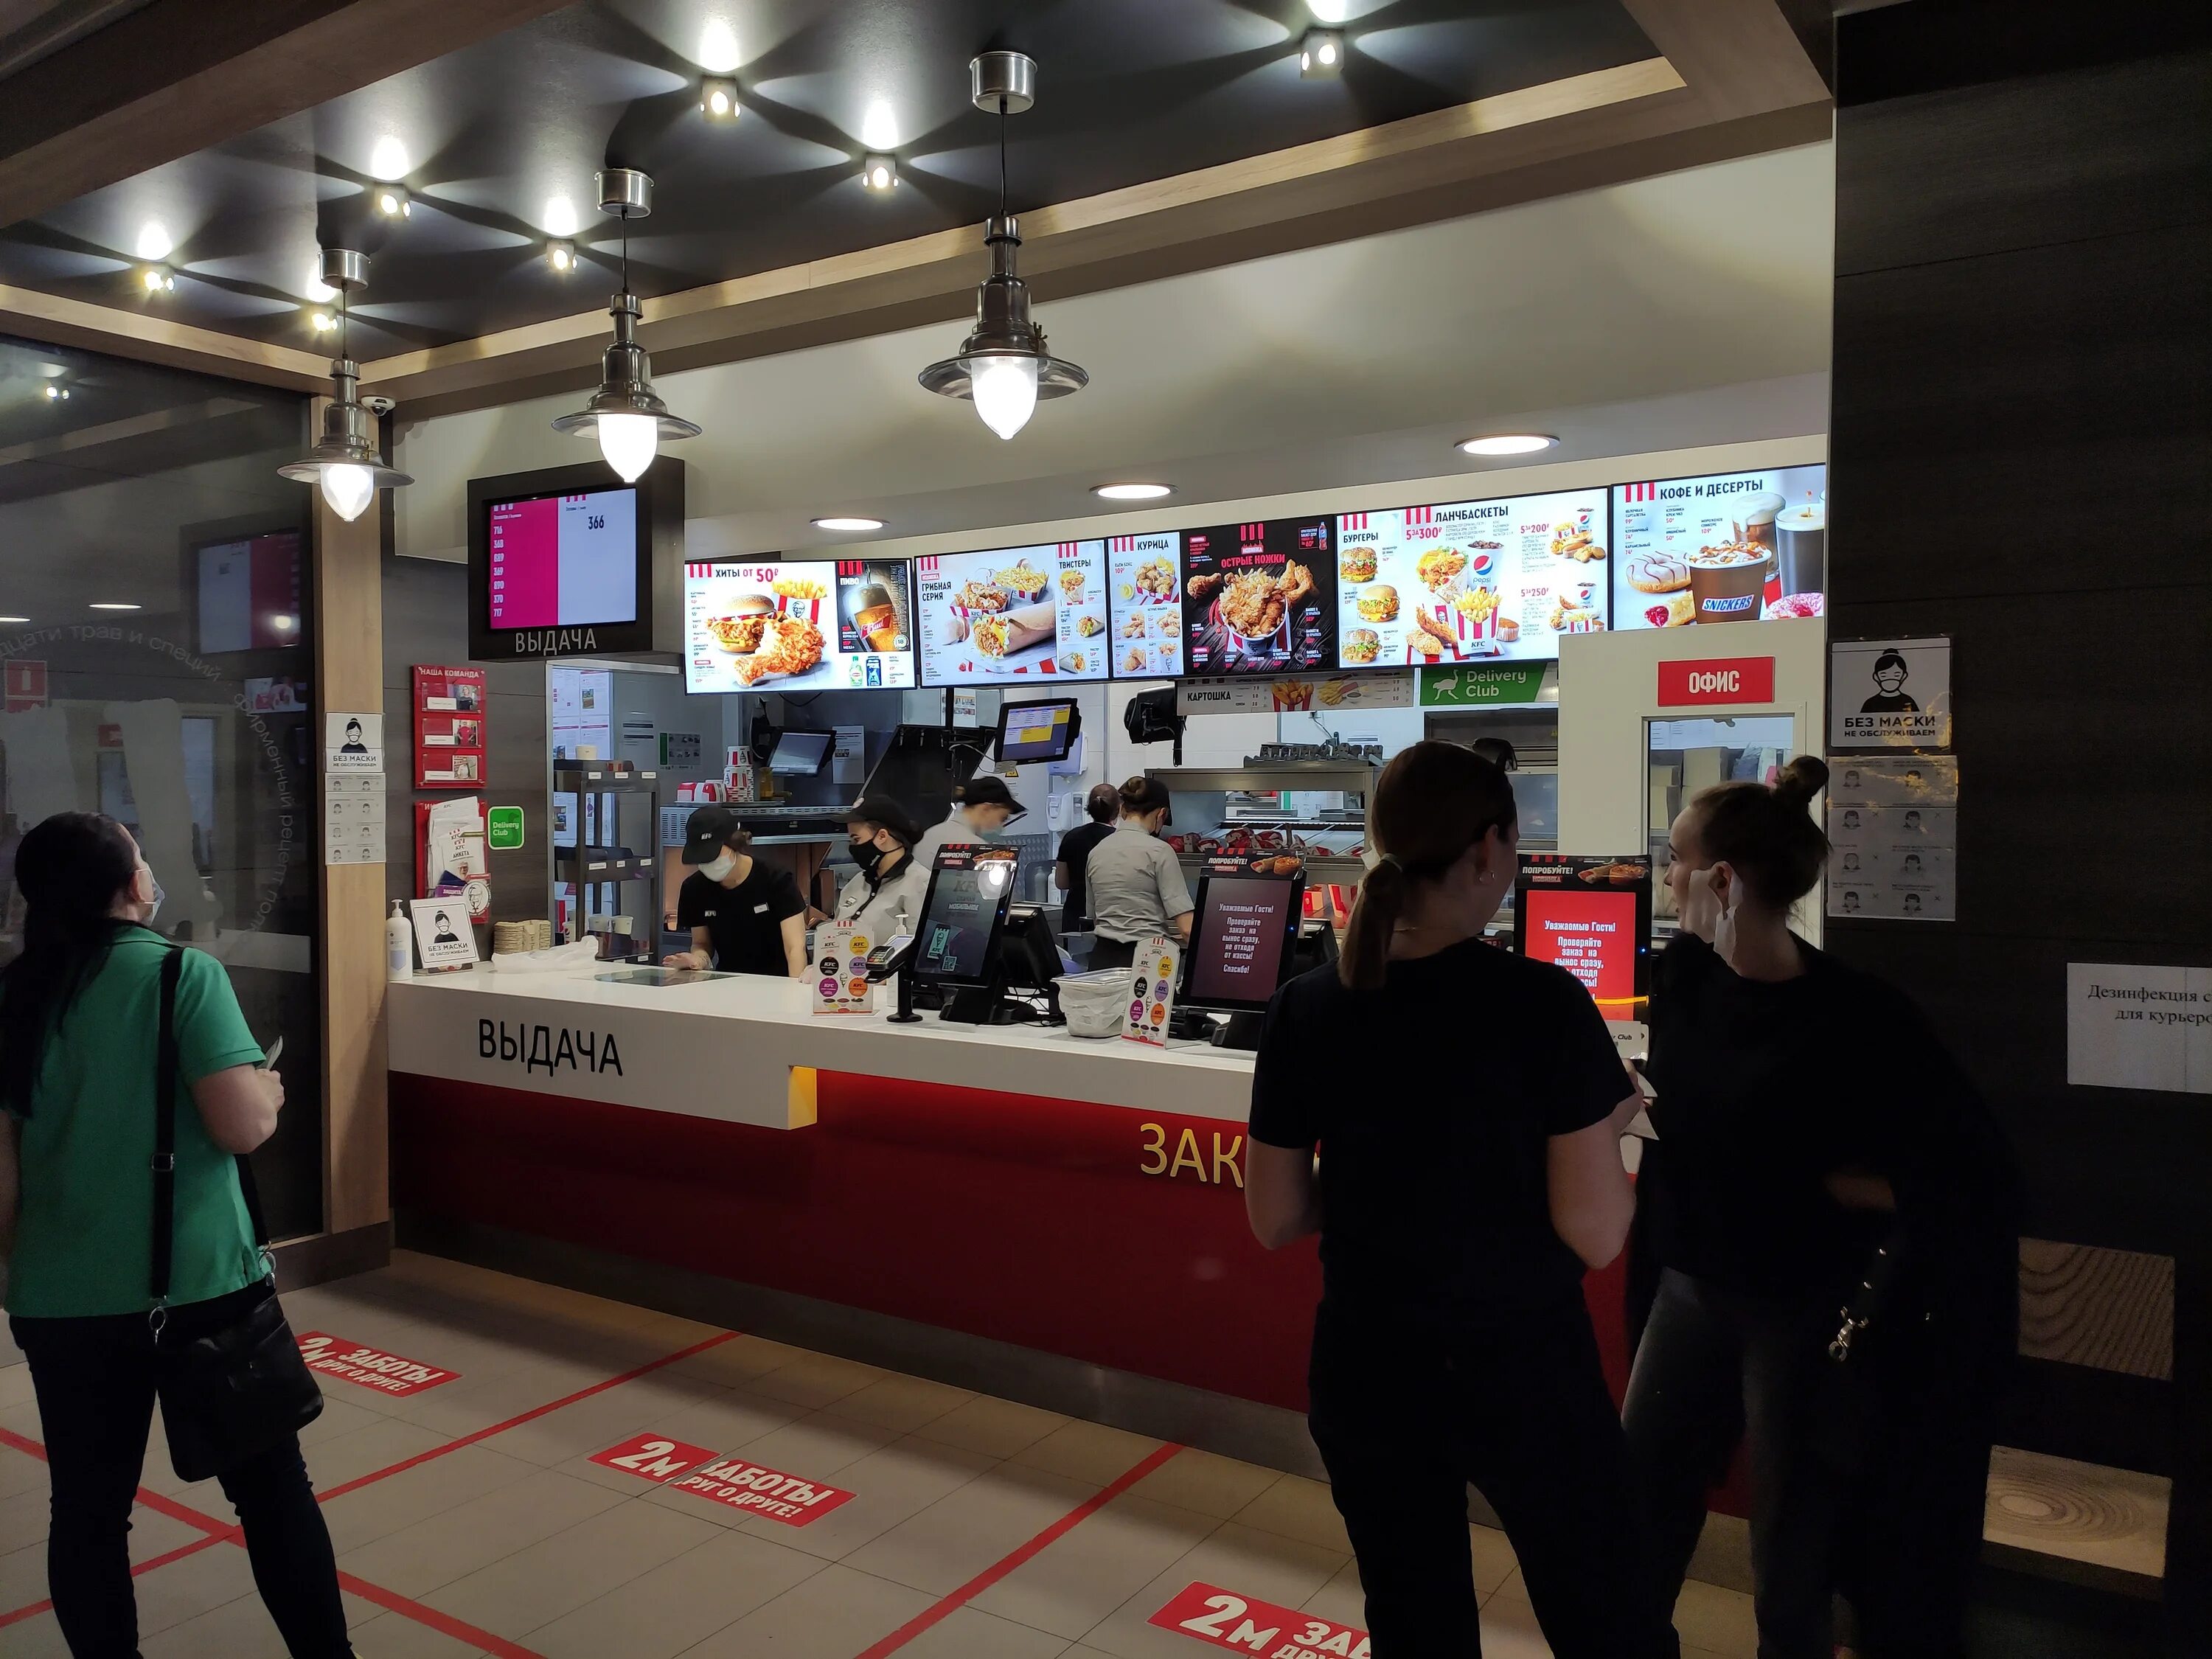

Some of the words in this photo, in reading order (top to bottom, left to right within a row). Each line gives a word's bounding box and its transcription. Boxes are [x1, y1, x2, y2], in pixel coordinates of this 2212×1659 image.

[1660, 487, 1691, 500] КОФЕ
[1696, 485, 1703, 496] И
[1706, 479, 1763, 497] ДЕСЕРТЫ
[1435, 506, 1509, 523] ЛАНЧБАСКЕТЫ
[588, 515, 605, 529] 366
[493, 526, 503, 535] 716
[1343, 532, 1378, 543] БУРГЕРЫ
[1137, 540, 1169, 552] КУРИЦА
[1059, 559, 1091, 569] ТВИСТЕРЫ
[1221, 556, 1253, 568] ОСТРЫЕ
[1255, 554, 1285, 565] НОЖКИ
[715, 568, 740, 578] ХИТЫ
[743, 568, 753, 577] ОТ
[839, 577, 860, 586] ПИВО
[922, 581, 952, 592] ГРИБНАЯ
[922, 592, 944, 602] СЕРИЯ
[1704, 596, 1752, 611] SNICKERS
[516, 628, 597, 656] ВЫДАЧА
[420, 668, 443, 676] НАША
[445, 669, 479, 678] КОМАНДА
[1467, 669, 1526, 684] Delivery
[1688, 670, 1740, 693] ОФИС
[1187, 690, 1231, 702] КАРТОШКА
[1466, 684, 1500, 698] Club
[68, 625, 123, 641] трав
[149, 635, 222, 682] специй
[232, 692, 293, 809] фирменный
[1844, 717, 1874, 728] БЕЗ
[1879, 715, 1935, 727] МАСКИ
[1860, 728, 1935, 738] ОБСЛУЖИВАЕМ
[493, 821, 519, 830] Delivery
[1208, 856, 1248, 866] ПОПРОБУЙТЕ!
[1522, 865, 1573, 875] ПОПРОБУЙТЕ!
[1219, 902, 1253, 914] Уважаемые
[1254, 904, 1274, 914] Гости!
[1226, 917, 1262, 927] Проверяйте
[1544, 919, 1590, 931] Уважаемые
[1591, 921, 1616, 933] Гости!
[1228, 926, 1246, 934] заказ
[443, 942, 468, 950] МАСКИ
[1242, 936, 1260, 945] сразу,
[1557, 936, 1601, 948] Проверяйте
[1234, 945, 1255, 953] отходя
[1561, 948, 1583, 956] заказ
[1587, 948, 1597, 957] на
[1232, 952, 1253, 960] кассы!
[1223, 964, 1250, 974] Спасибо!
[1580, 958, 1604, 969] сразу,
[2088, 984, 2197, 1003] Дезинфекция
[2115, 1009, 2143, 1020] для
[477, 1019, 623, 1077] ВЫДАЧА
[1141, 1123, 1244, 1188] ЗАК
[310, 1359, 357, 1373] ДРУГ
[338, 1349, 445, 1383] ЗАБОТЫ
[347, 1369, 366, 1377] О
[353, 1372, 412, 1391] ДРУГЕ!
[717, 1486, 733, 1497] О
[729, 1491, 803, 1519] ДРУГЕ!
